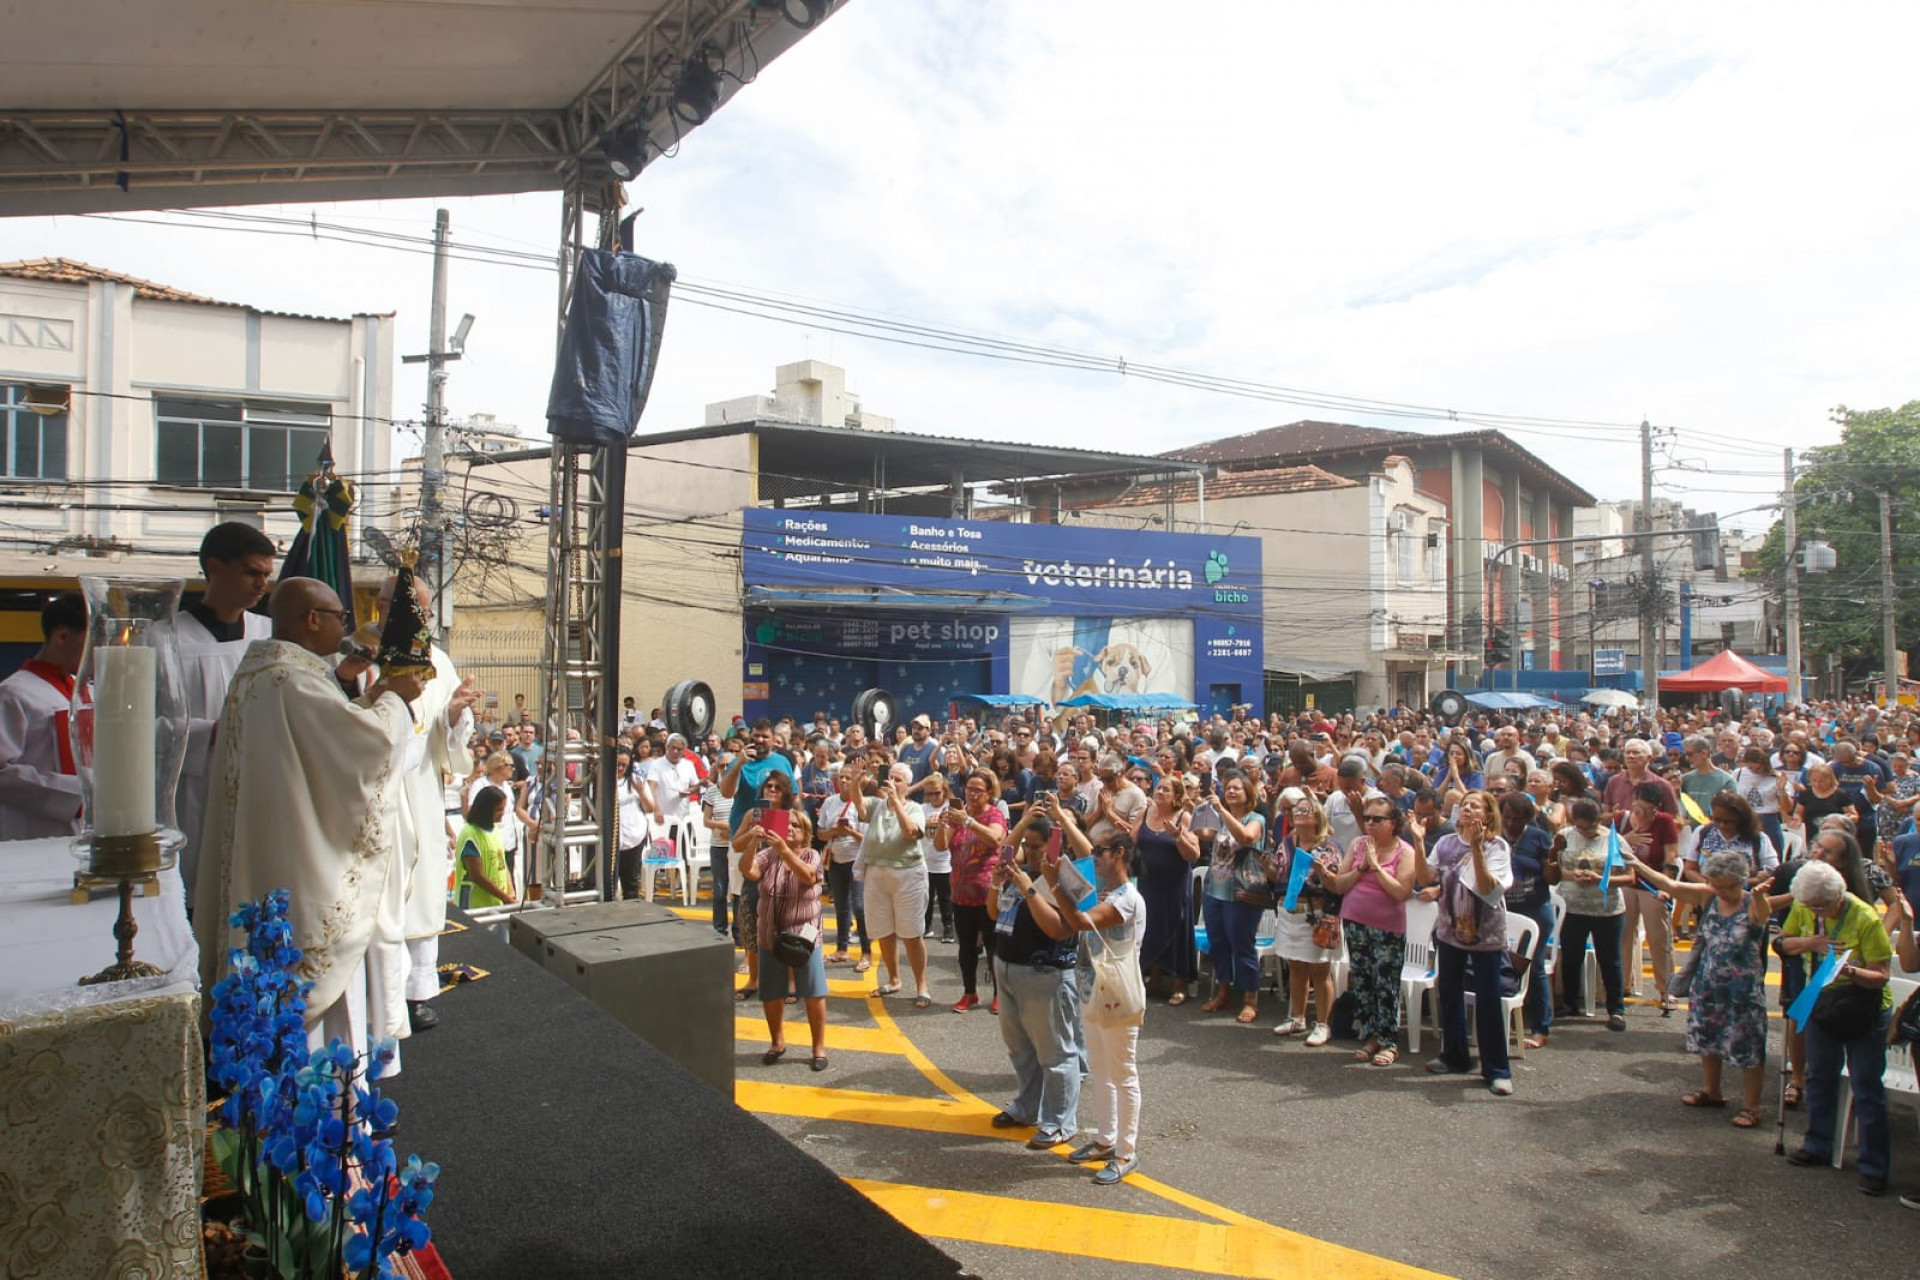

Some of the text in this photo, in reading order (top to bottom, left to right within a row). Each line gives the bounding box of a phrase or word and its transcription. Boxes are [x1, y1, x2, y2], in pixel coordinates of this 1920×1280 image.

[785, 519, 828, 534] Rações
[910, 525, 982, 540] Banho e Tosa
[785, 534, 871, 549] Medicamentos
[910, 540, 969, 553] Acessórios
[919, 556, 951, 568] muito
[1022, 558, 1193, 590] veterinária
[1214, 589, 1249, 603] bicho
[890, 619, 999, 644] pet shop
